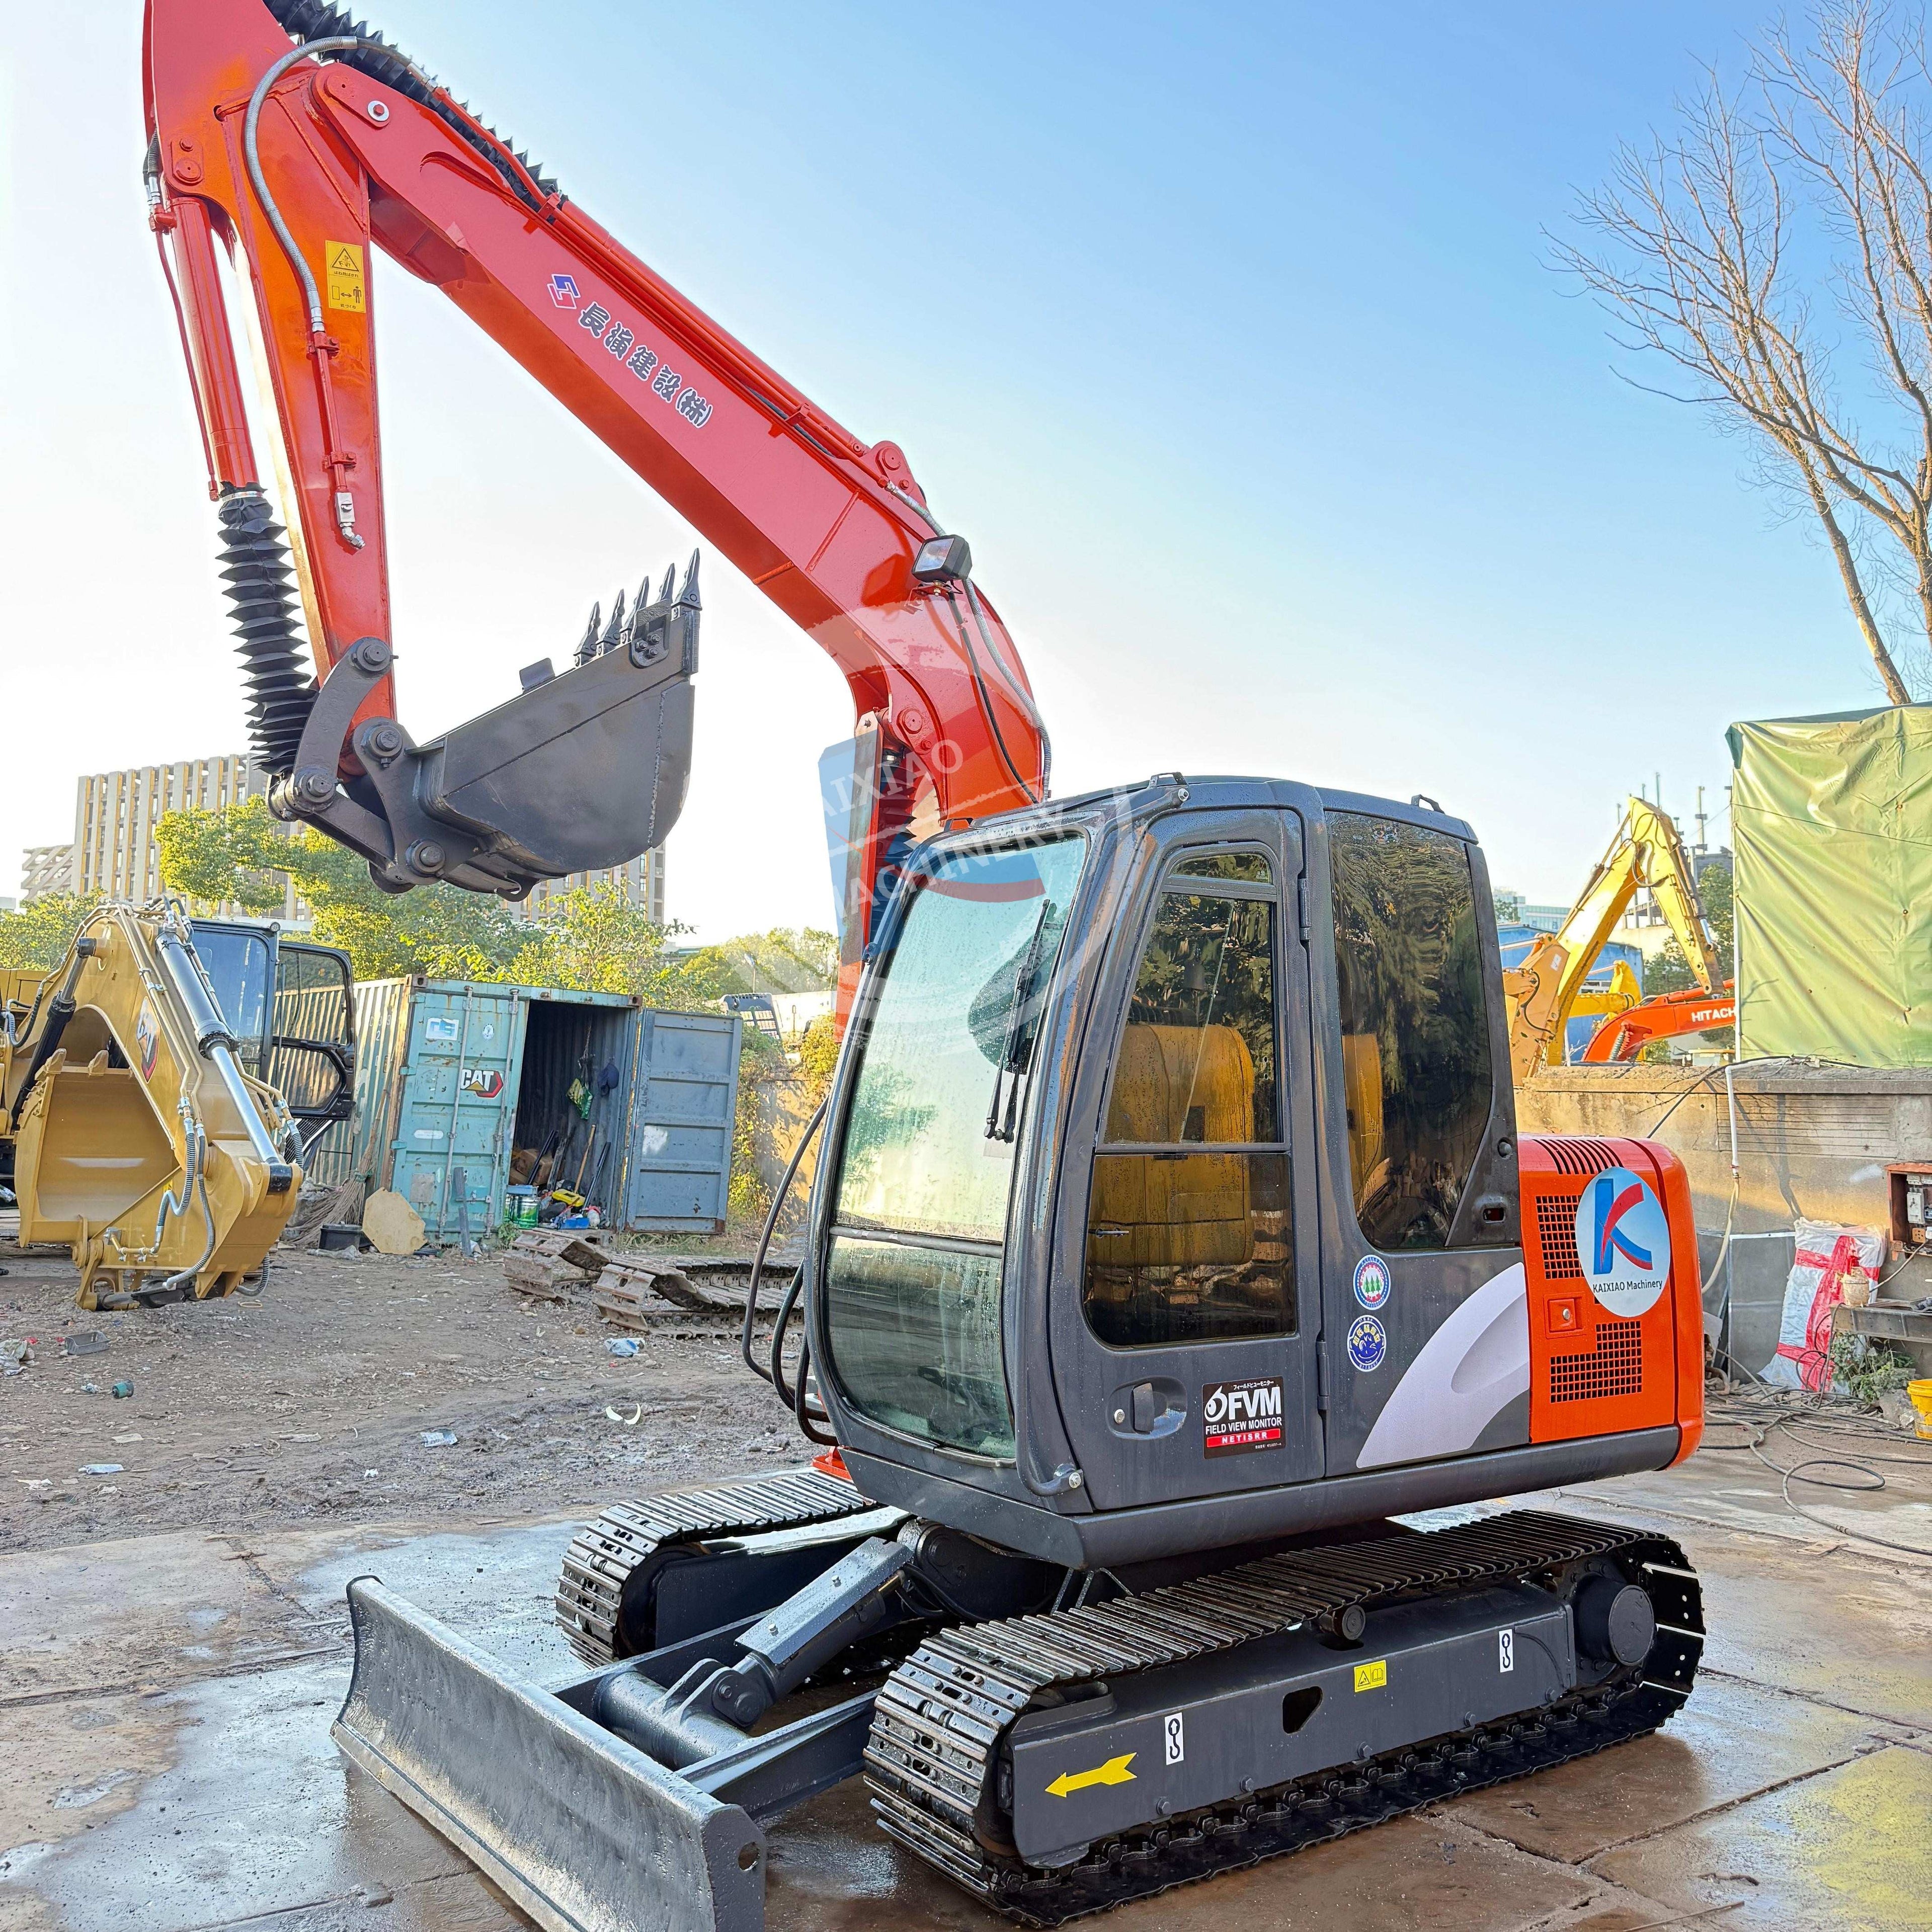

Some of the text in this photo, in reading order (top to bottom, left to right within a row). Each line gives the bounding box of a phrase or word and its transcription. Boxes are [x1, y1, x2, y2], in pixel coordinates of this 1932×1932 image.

[1691, 1006, 1736, 1022] HITACH
[460, 1069, 494, 1092] CAT
[1593, 1279, 1663, 1293] KAIXIAO Machinery
[1228, 1386, 1281, 1420] FVM
[1205, 1417, 1282, 1435] FIELD VIEW MONITOR
